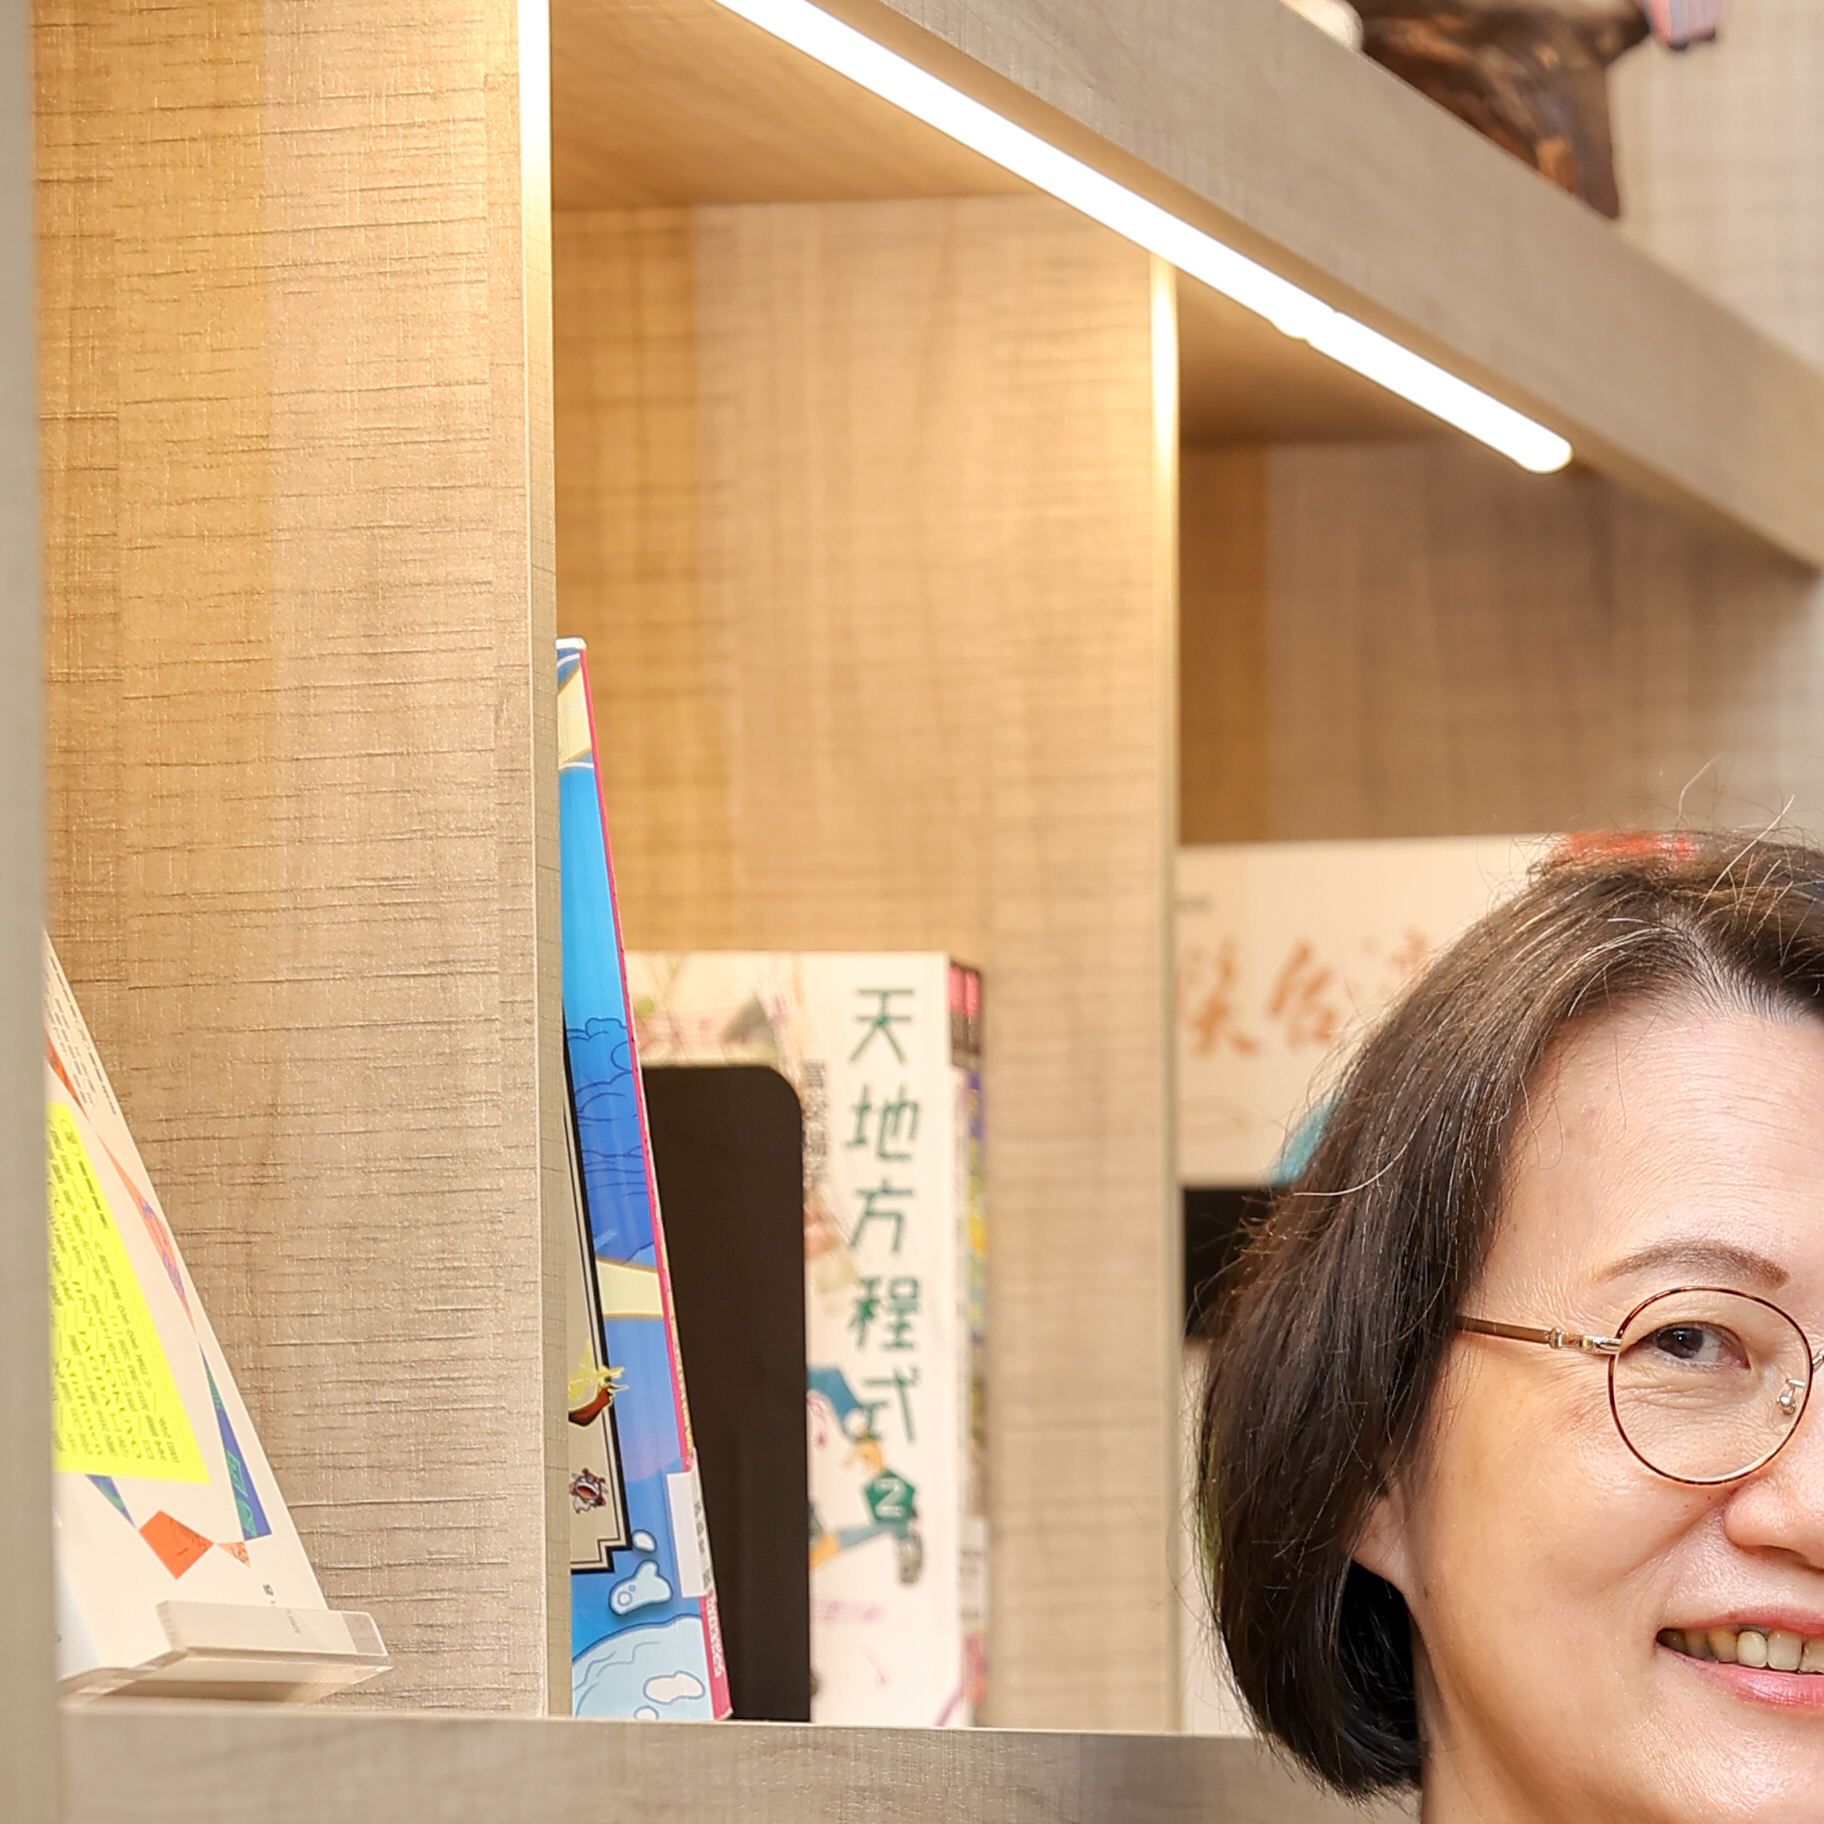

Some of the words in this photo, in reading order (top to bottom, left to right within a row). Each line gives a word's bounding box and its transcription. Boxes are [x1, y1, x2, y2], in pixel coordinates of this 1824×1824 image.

[845, 986, 922, 1440] 天地方程式
[876, 1476, 908, 1520] 2
